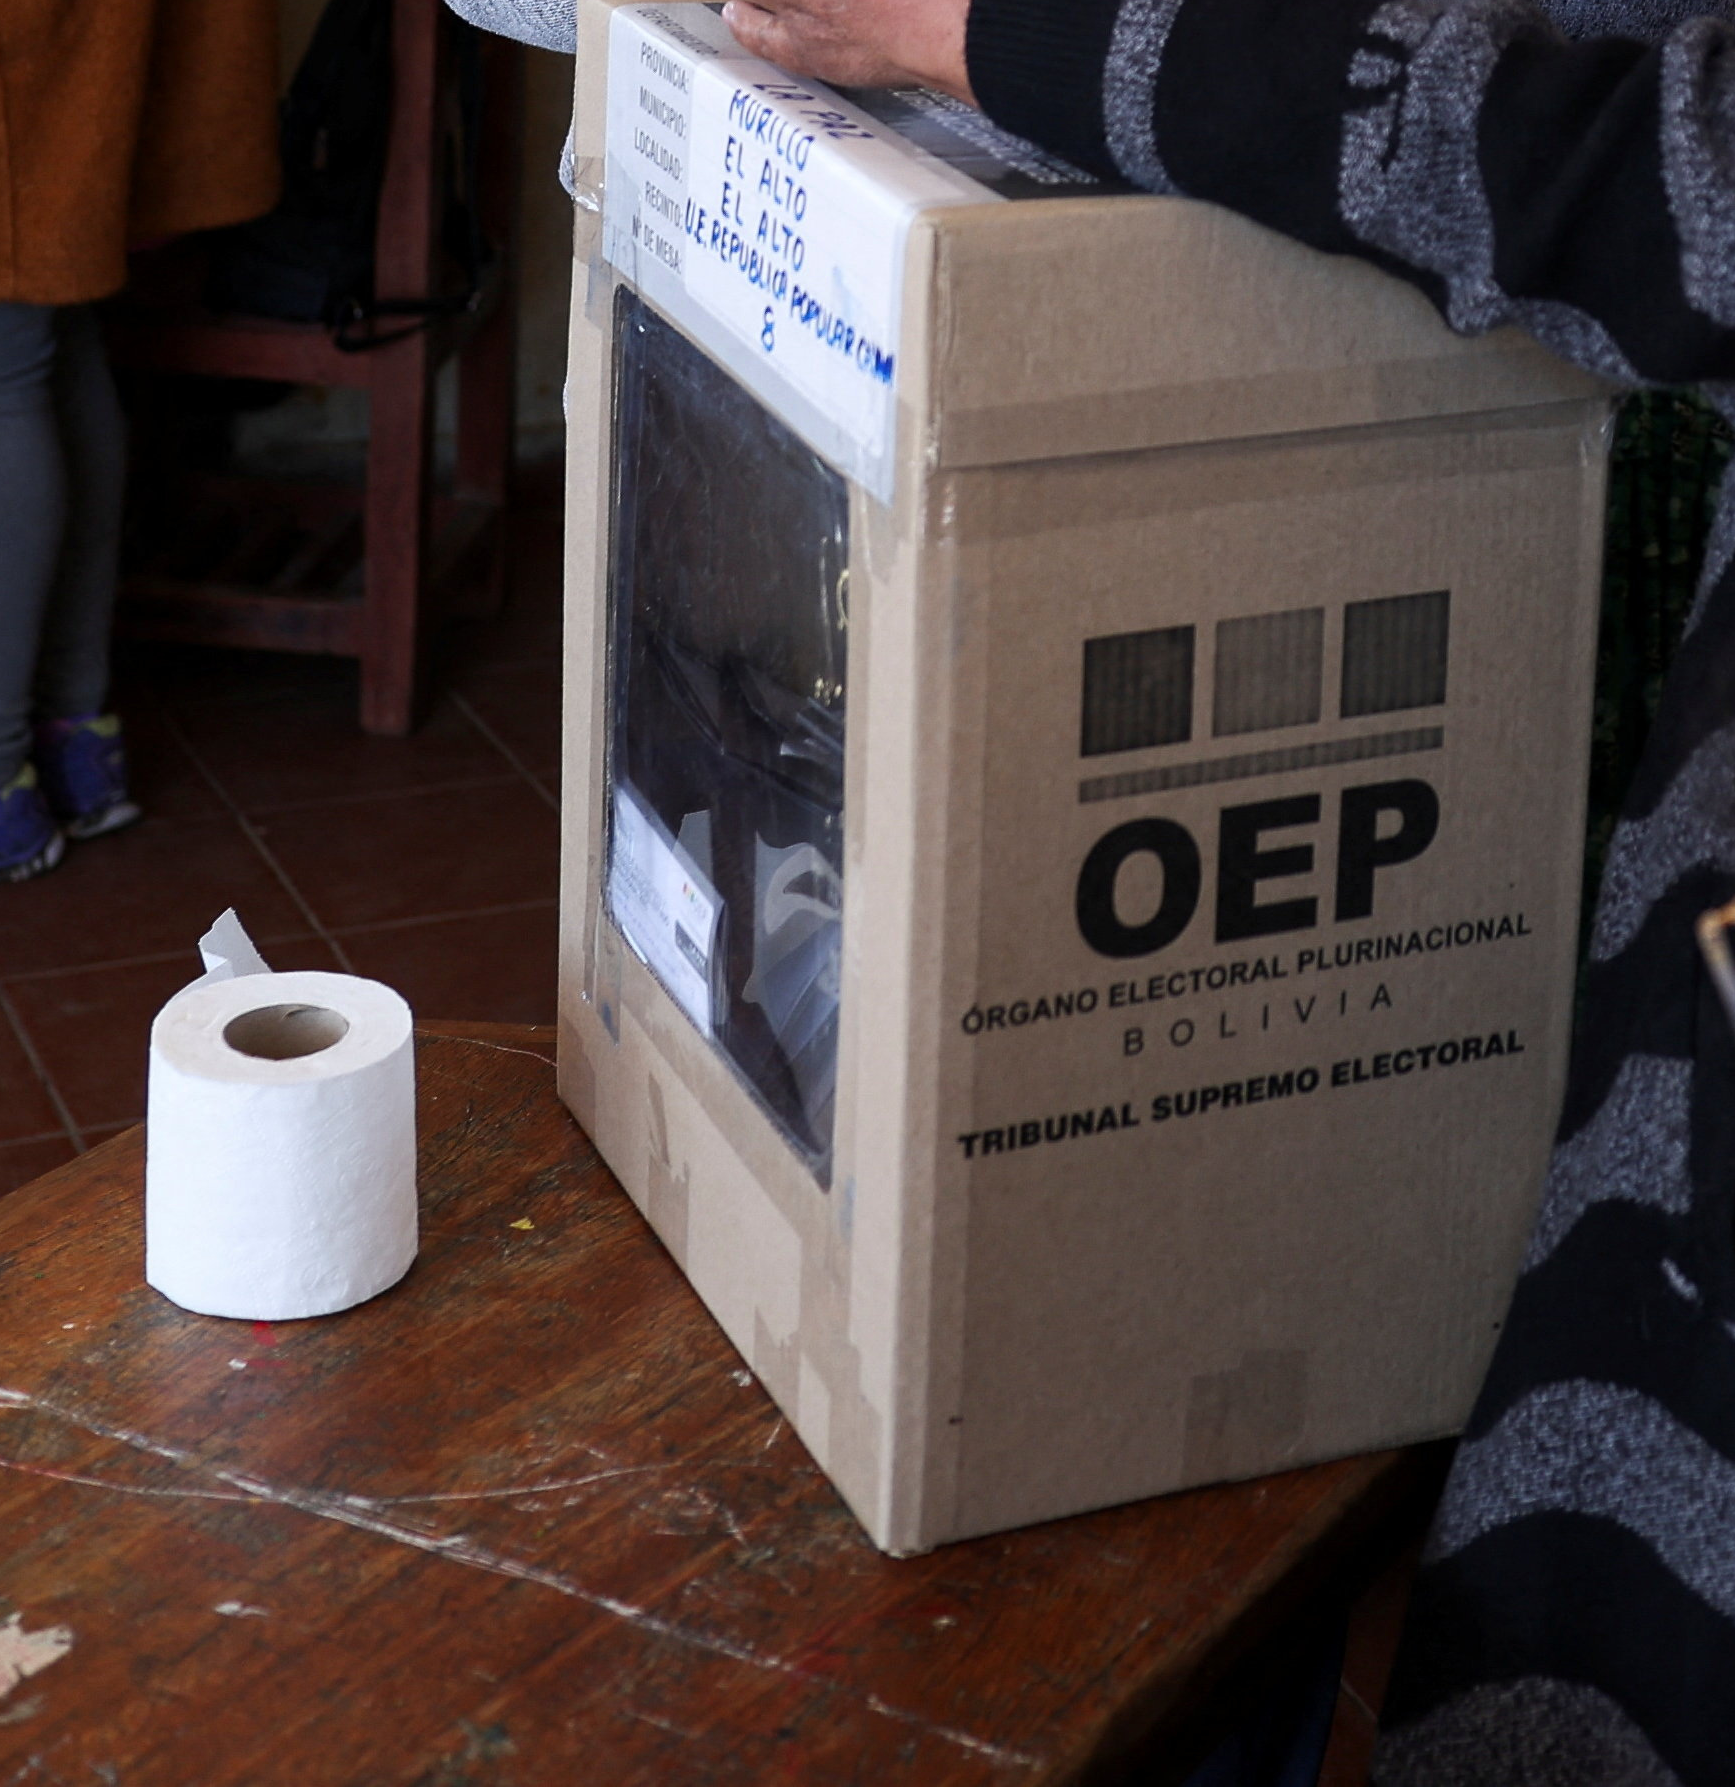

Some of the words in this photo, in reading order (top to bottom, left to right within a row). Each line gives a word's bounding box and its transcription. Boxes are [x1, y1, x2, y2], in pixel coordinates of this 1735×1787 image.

[640, 41, 689, 94] PROVINCIA:
[639, 86, 686, 140] MUNICIPIO:
[635, 127, 682, 182] LOCALIDAD:
[725, 135, 744, 179] EL
[759, 158, 806, 221] ALTO
[645, 181, 683, 230] RECINTO:
[721, 181, 742, 226] EL
[757, 210, 804, 272] ALTO
[711, 219, 787, 301] REPUBLICA
[1075, 777, 1440, 960] OEP
[962, 989, 1098, 1036] ÓRGANO
[1108, 954, 1287, 1009] ELECTORAL
[1297, 912, 1532, 975] PLURINACIONAL
[1124, 982, 1392, 1057] BOLIVIA
[958, 1105, 1139, 1159] TRIBUNAL
[1150, 1067, 1319, 1122] SUPREMO
[1331, 1029, 1525, 1086] ELECTORAL
